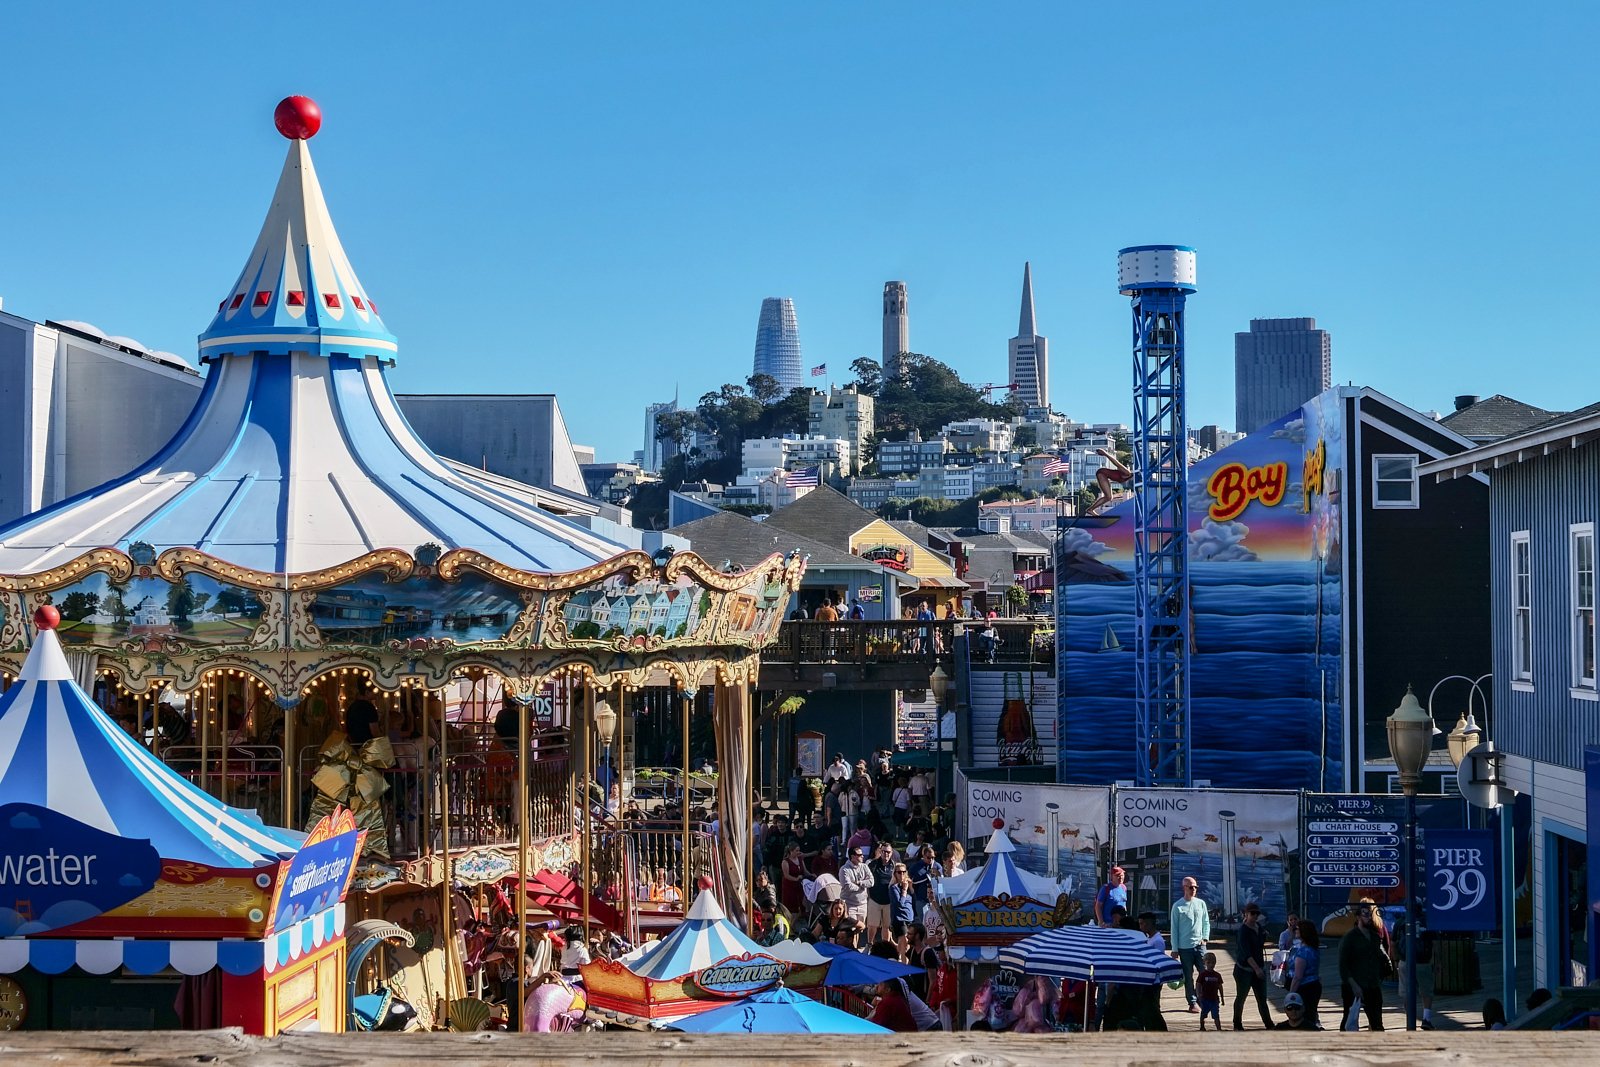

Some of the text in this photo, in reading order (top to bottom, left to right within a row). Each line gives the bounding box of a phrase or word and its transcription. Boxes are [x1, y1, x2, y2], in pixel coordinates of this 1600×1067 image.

[1208, 462, 1287, 521] Bay
[972, 788, 1022, 803] COMING
[1123, 797, 1188, 811] COMING
[1338, 799, 1360, 809] PIER
[1360, 799, 1371, 809] 39
[972, 804, 1006, 819] SOON
[1122, 815, 1167, 829] SOON
[1325, 823, 1381, 831] CHART HOUSE
[1333, 836, 1378, 845] BAY VIEWS
[1328, 850, 1380, 858] RESTROOMS
[1433, 848, 1484, 866] PIER
[0, 847, 97, 886] water
[1323, 864, 1386, 872] LEVEL 2 SHOPS
[1334, 877, 1379, 886] SEA LIONS
[1432, 868, 1487, 911] 39
[954, 910, 1055, 928] CHURROS
[700, 963, 787, 986] CARICATURES
